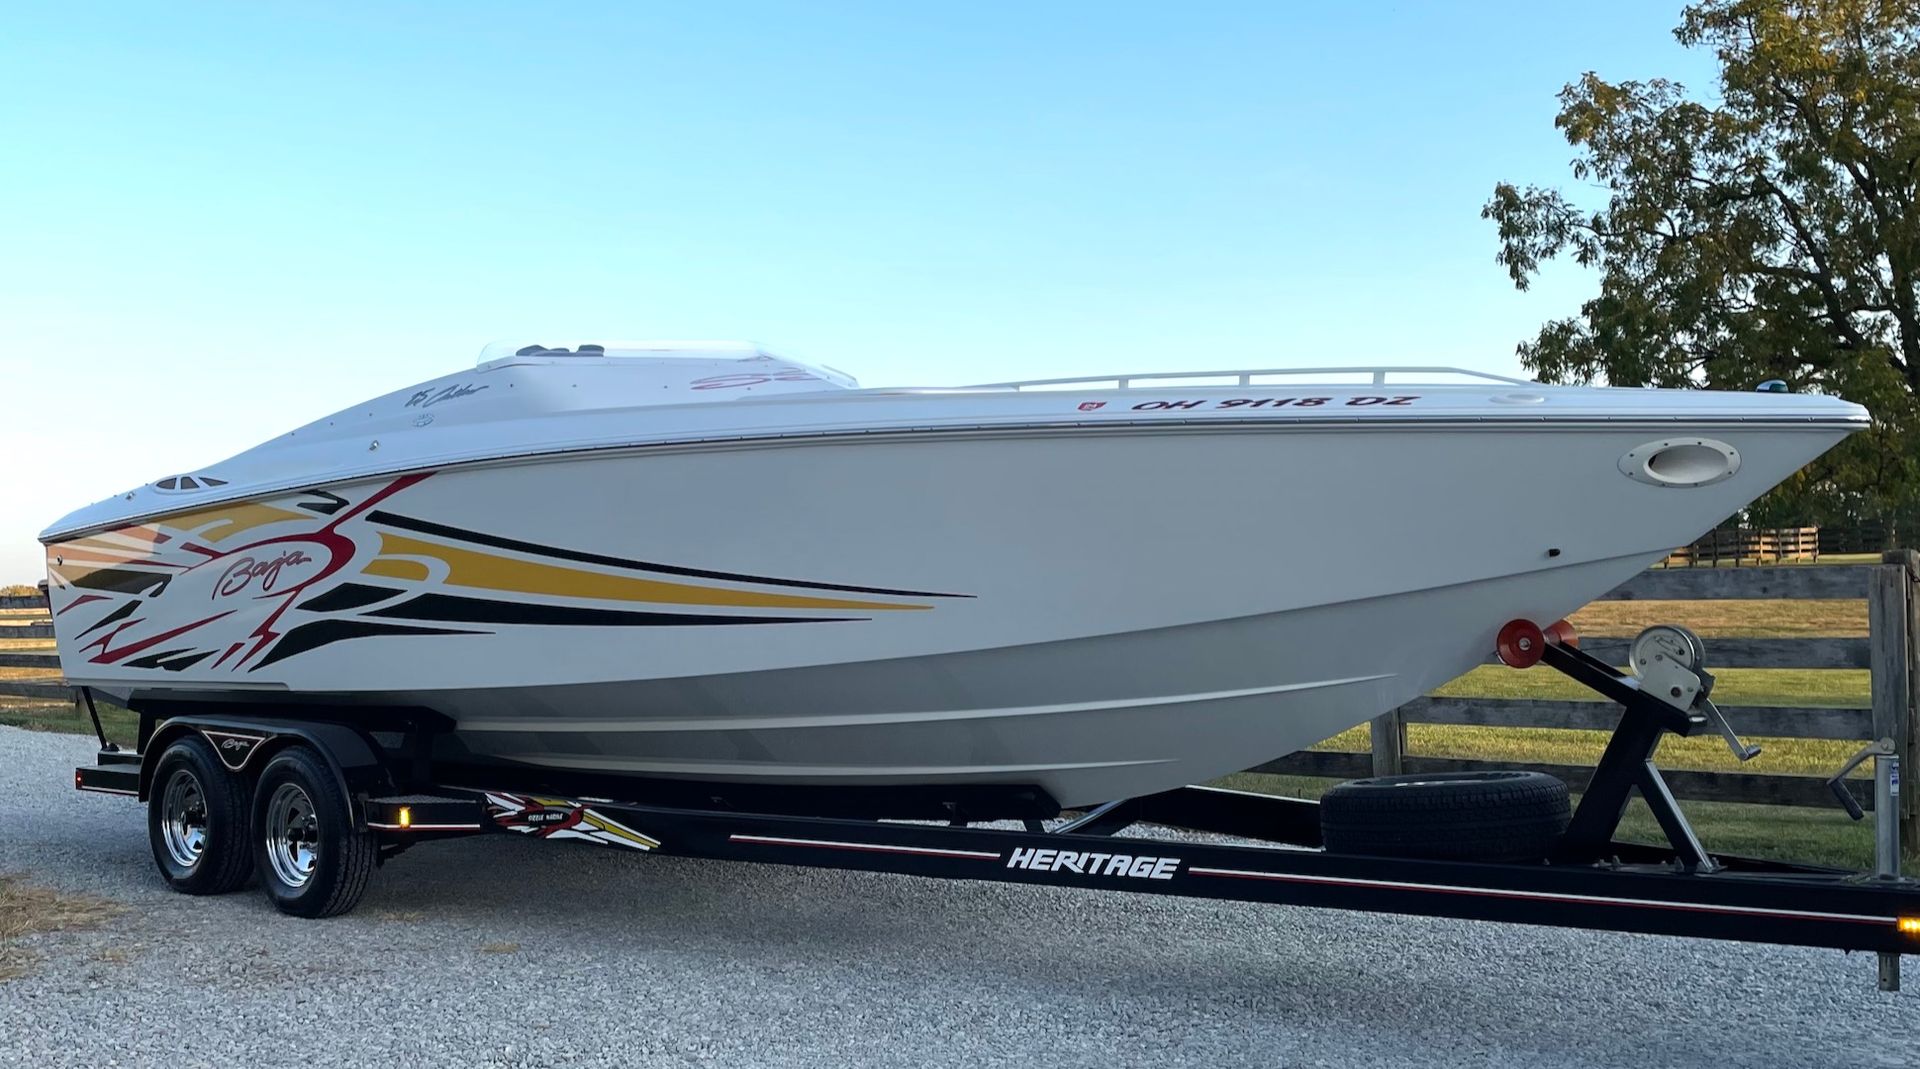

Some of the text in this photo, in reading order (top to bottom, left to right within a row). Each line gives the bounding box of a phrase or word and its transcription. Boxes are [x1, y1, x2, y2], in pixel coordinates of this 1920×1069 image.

[1131, 396, 1422, 410] OH 9118 DZ
[211, 549, 312, 600] Baja
[1006, 847, 1181, 880] HERITAGE
